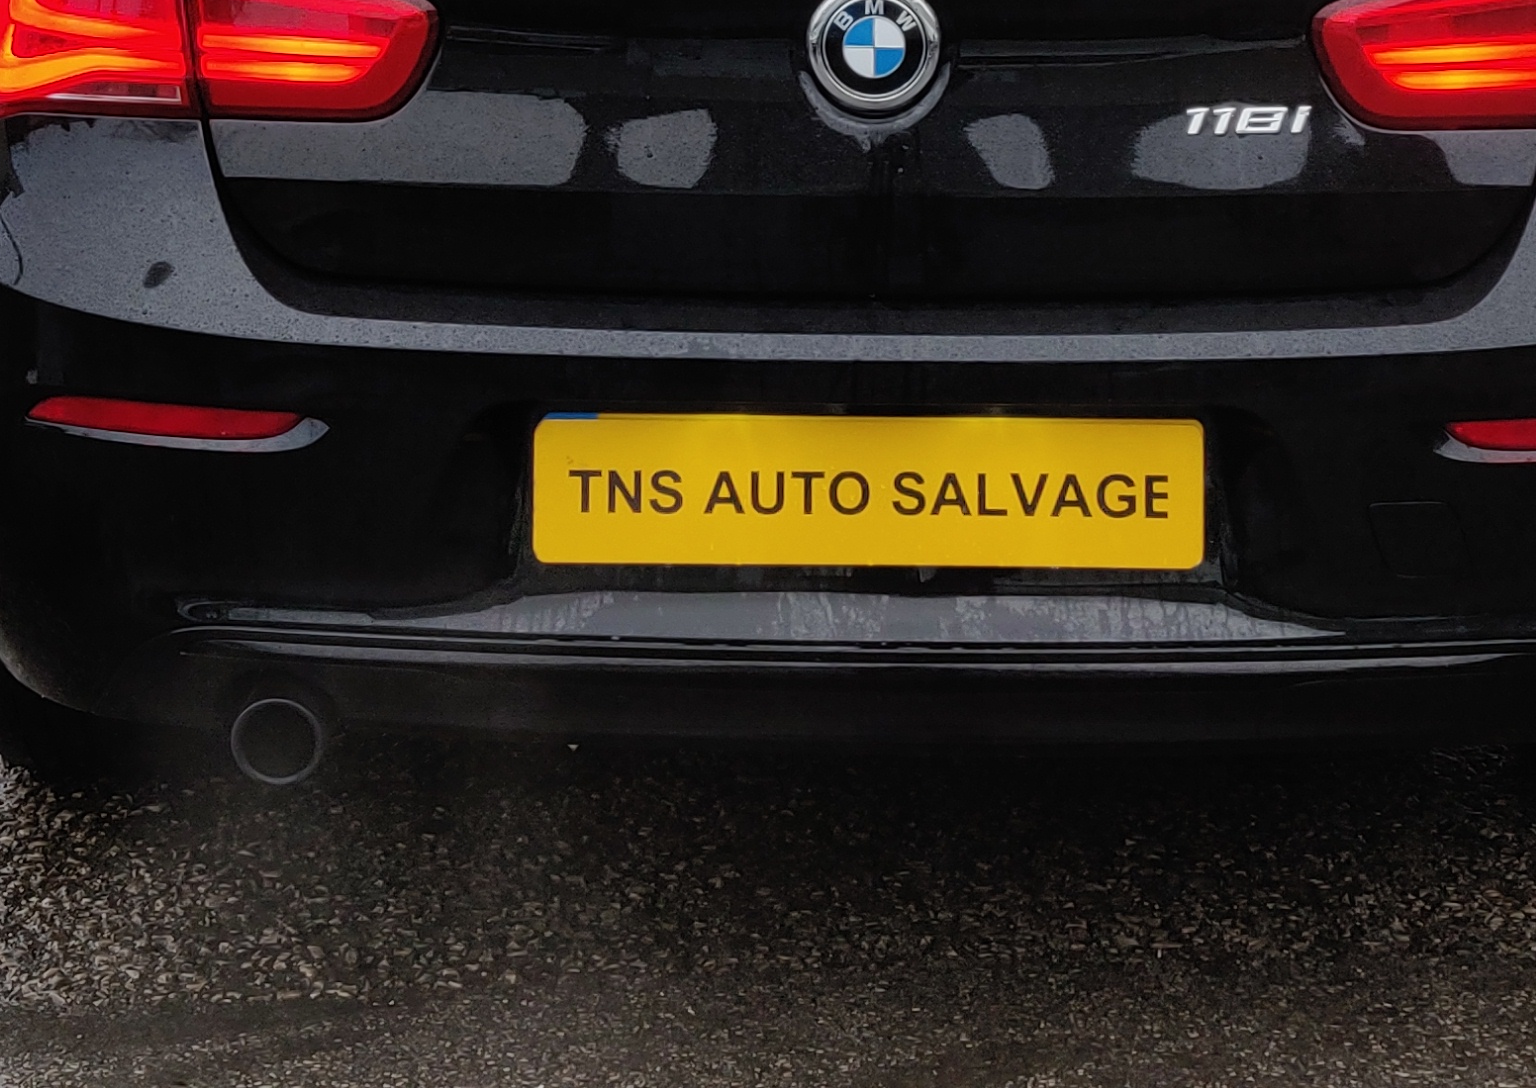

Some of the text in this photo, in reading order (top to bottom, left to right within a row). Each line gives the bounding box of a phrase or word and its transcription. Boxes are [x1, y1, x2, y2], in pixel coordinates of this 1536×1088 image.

[834, 0, 917, 32] BMW
[569, 470, 1169, 518] TNS AUTO SALVAGE
